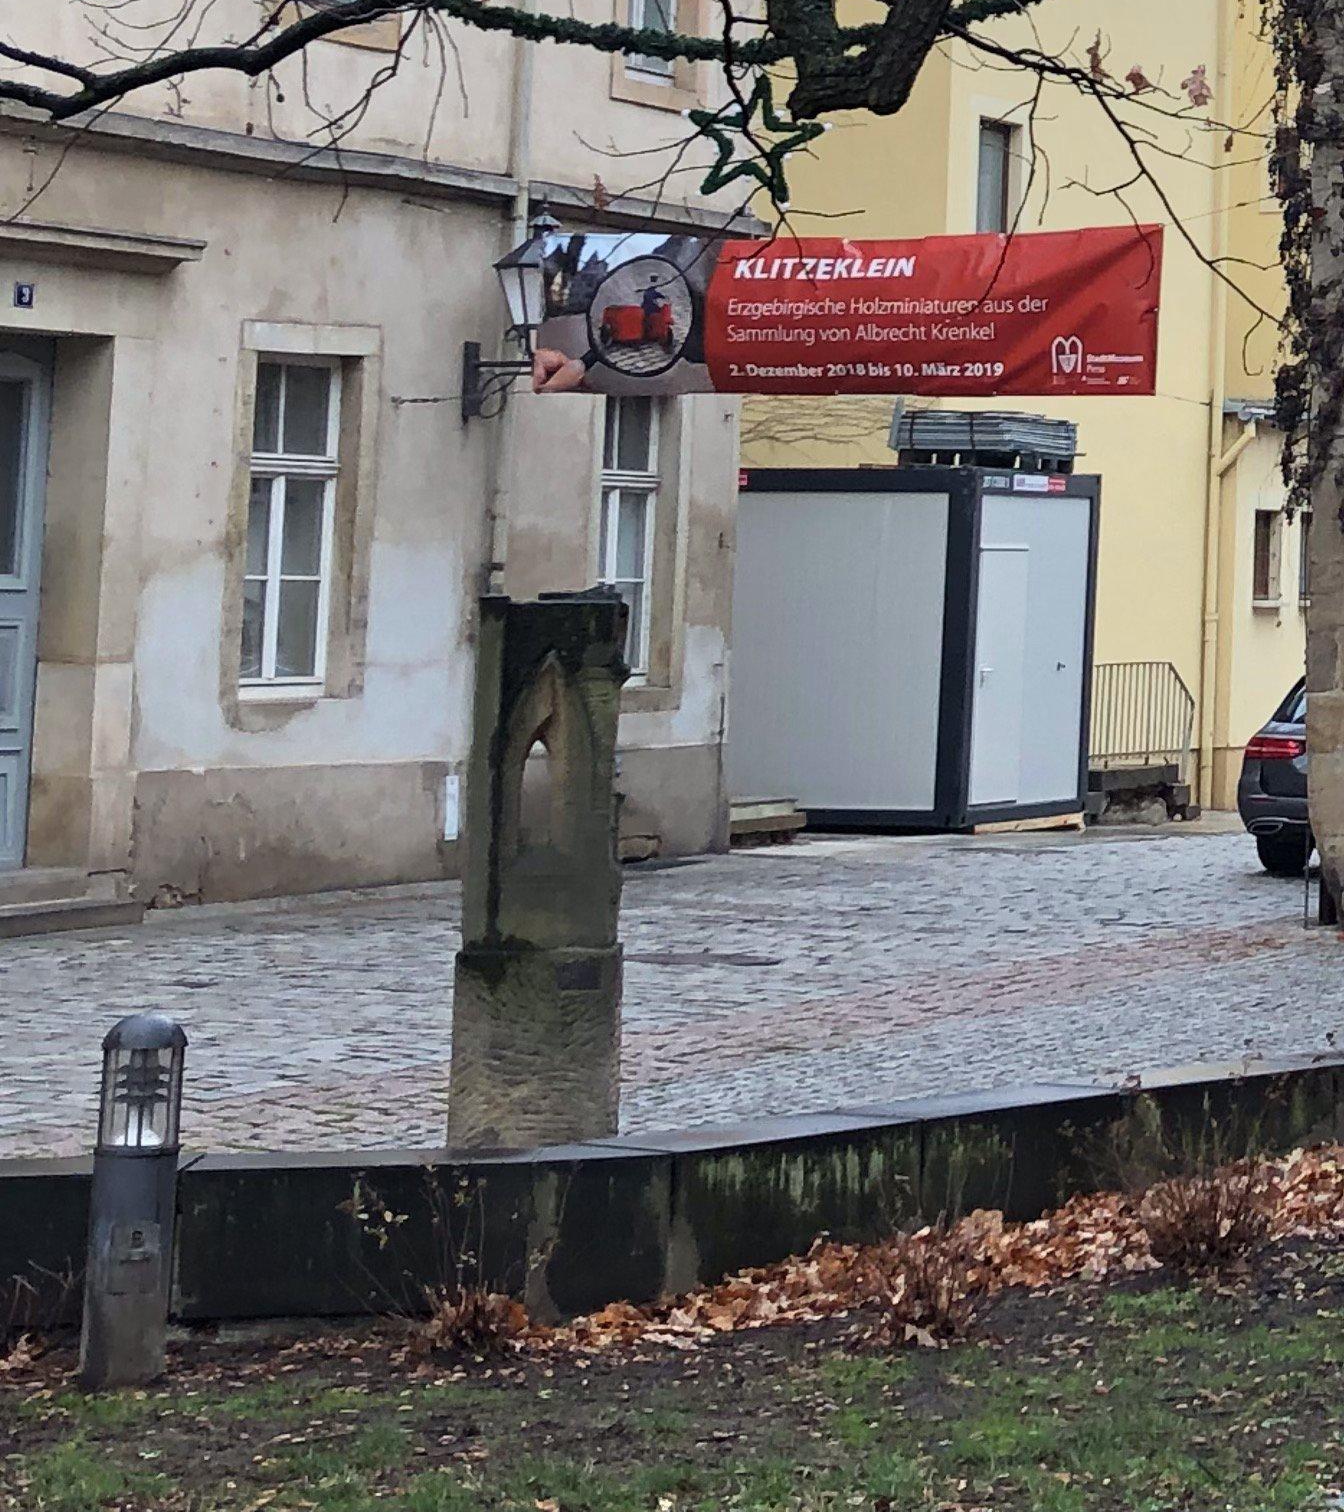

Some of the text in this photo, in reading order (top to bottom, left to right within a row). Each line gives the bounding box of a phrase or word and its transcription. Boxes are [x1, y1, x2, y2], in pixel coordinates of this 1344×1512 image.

[733, 255, 916, 280] KLITZEKLEIN
[727, 295, 1049, 320] Erzgebirgische Holzminiaturen aus der
[727, 322, 995, 346] Sammlung von Albrecht Krenkel
[730, 363, 1004, 377] 2. Dezember 2018 bis 10. März 2019
